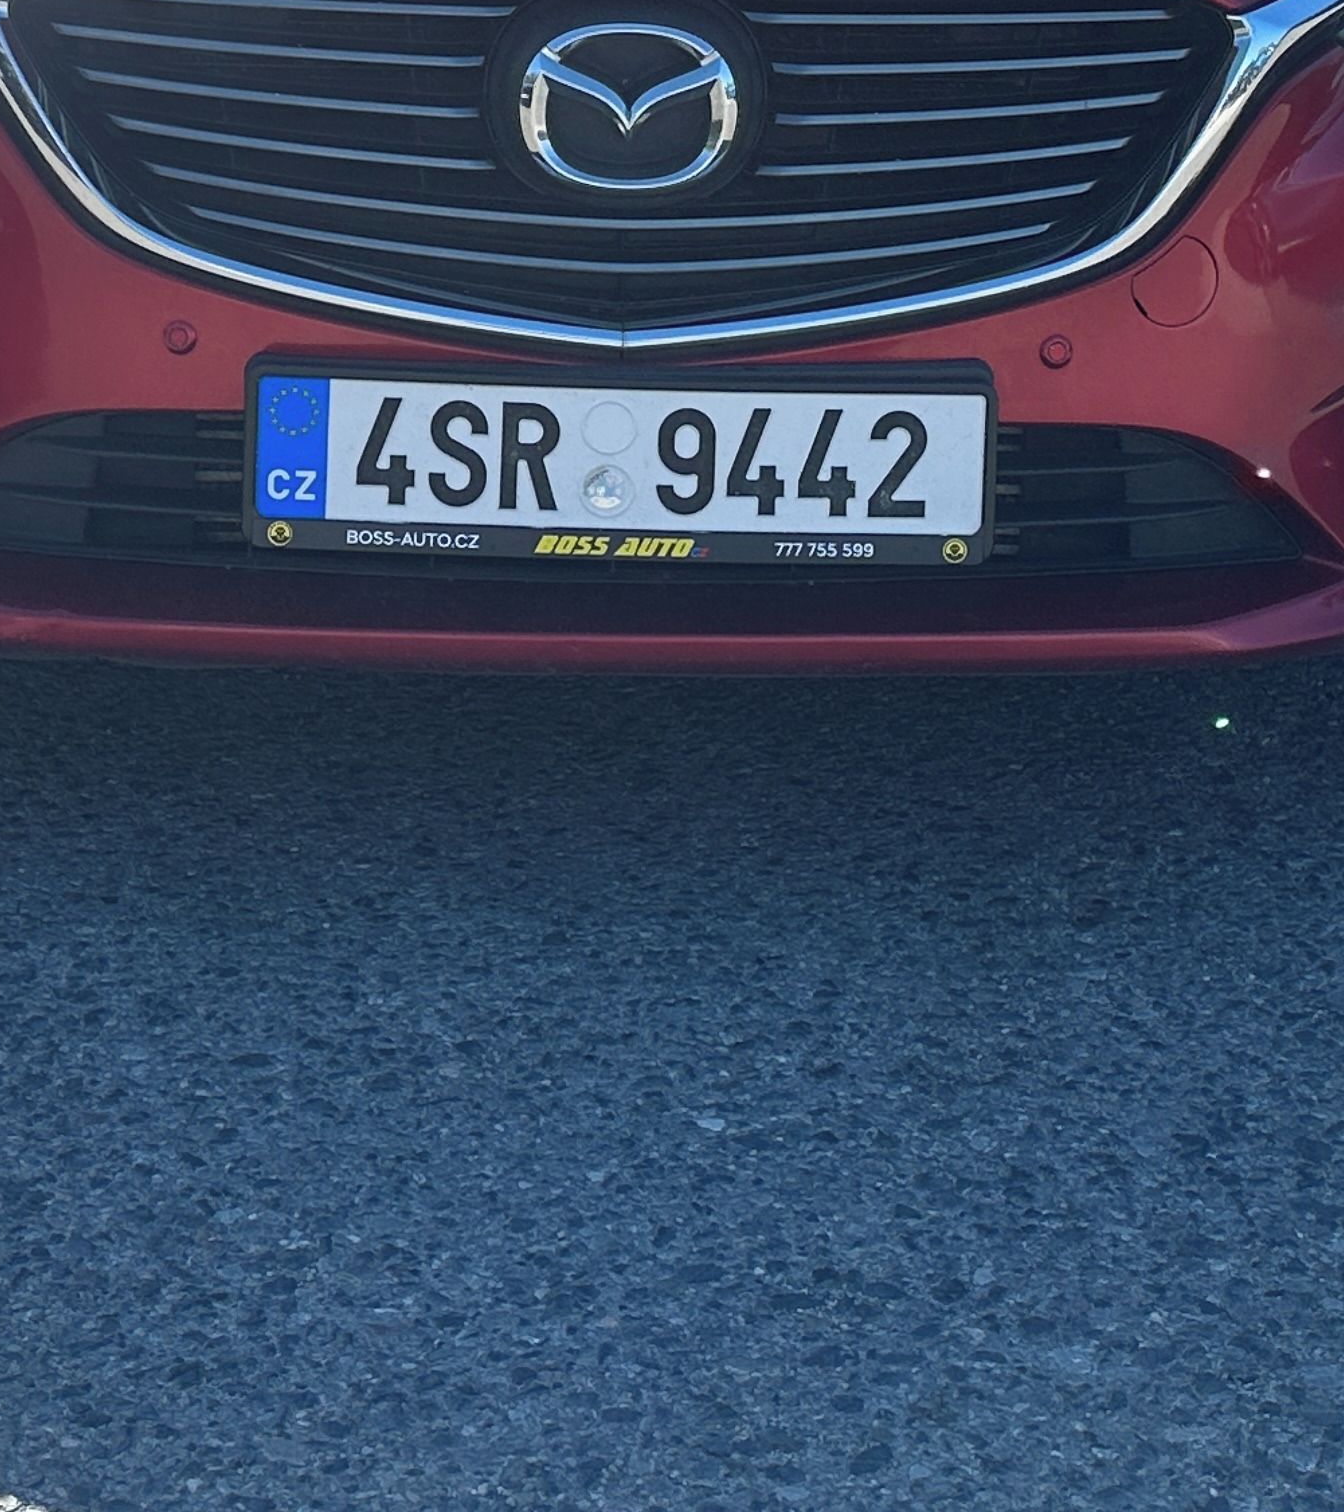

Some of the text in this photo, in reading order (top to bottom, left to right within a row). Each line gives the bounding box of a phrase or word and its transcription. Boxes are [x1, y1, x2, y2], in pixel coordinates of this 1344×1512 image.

[355, 396, 929, 518] 4SR 9442
[267, 469, 318, 501] CZ
[346, 529, 480, 549] BOSS-AUTO.CZ
[533, 535, 610, 556] BOSS
[613, 537, 695, 558] AUTO
[774, 541, 875, 559] 777 755 599
